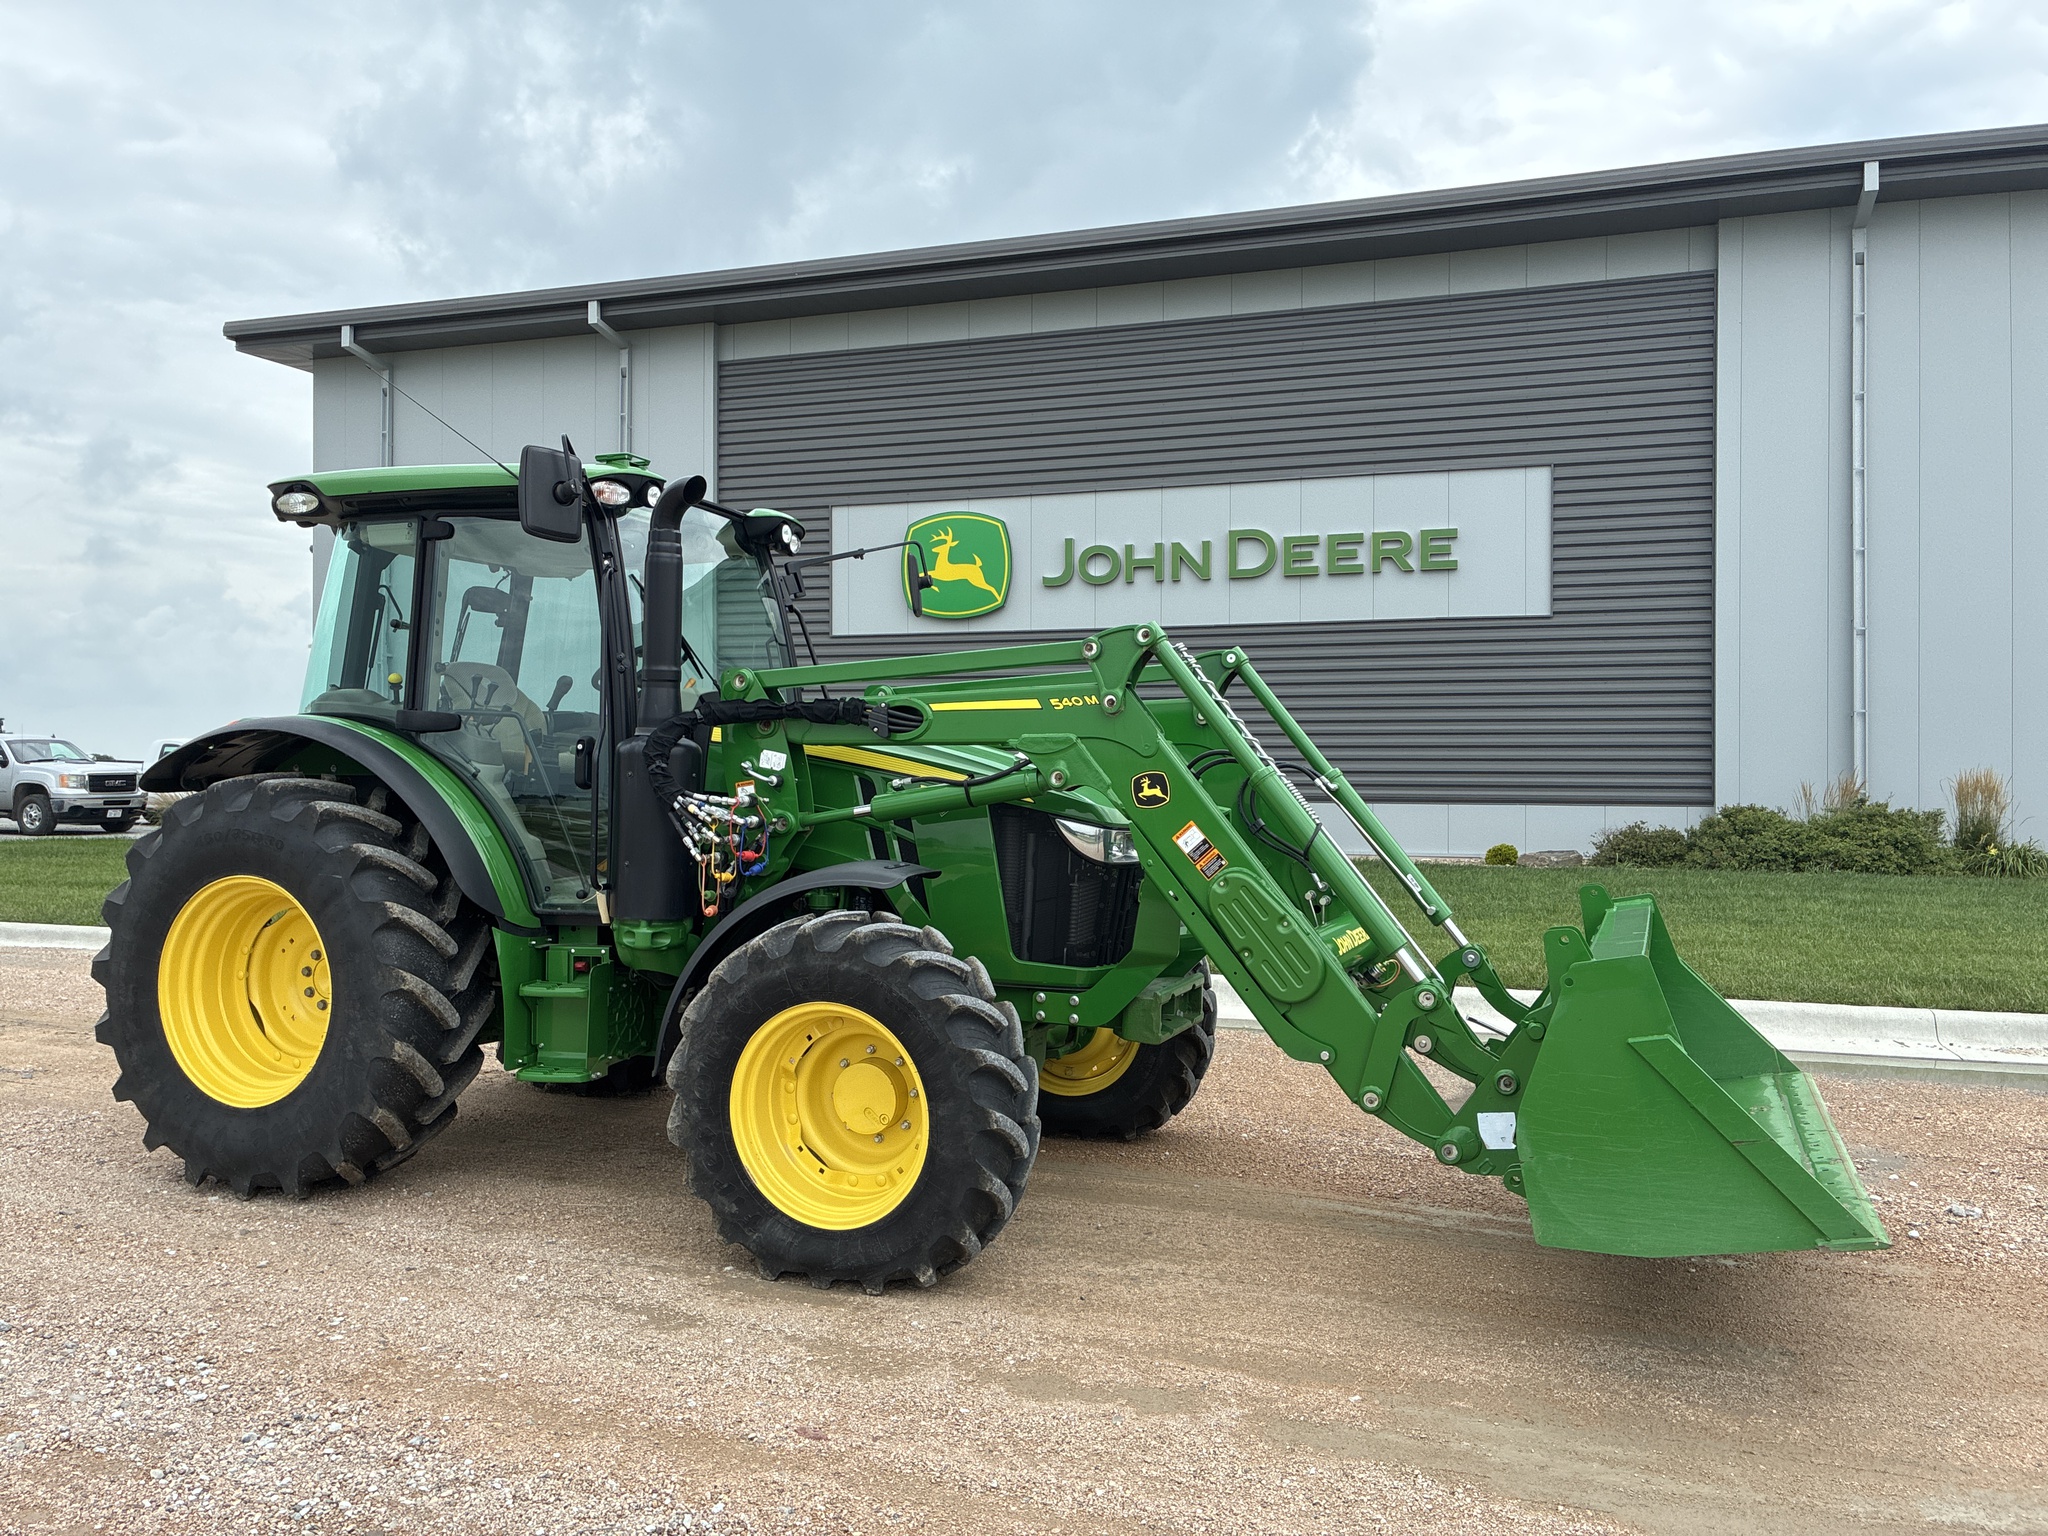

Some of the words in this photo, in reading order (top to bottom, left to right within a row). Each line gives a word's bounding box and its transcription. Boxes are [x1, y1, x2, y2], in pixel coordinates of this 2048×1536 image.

[1042, 538, 1212, 587] JOHN
[1228, 528, 1459, 579] DEERE
[1049, 696, 1084, 710] 540
[1083, 694, 1100, 705] M
[104, 779, 127, 787] GMC
[1332, 936, 1355, 956] JOHN
[1346, 926, 1370, 947] DEER
